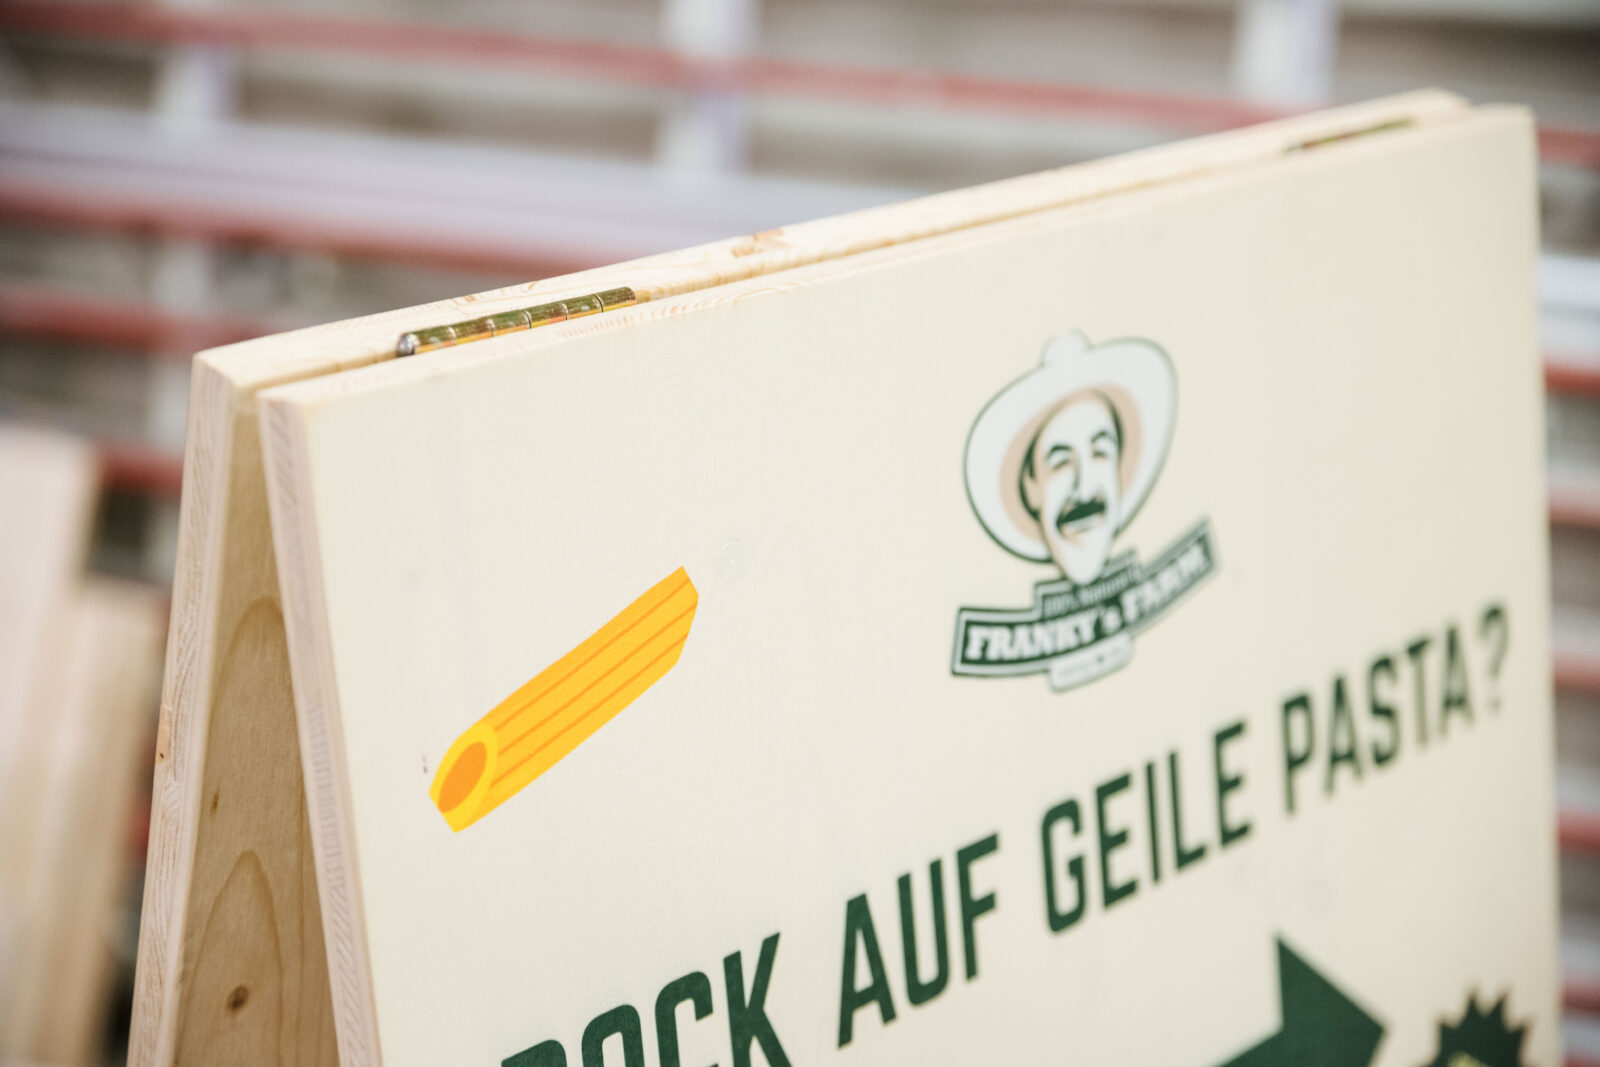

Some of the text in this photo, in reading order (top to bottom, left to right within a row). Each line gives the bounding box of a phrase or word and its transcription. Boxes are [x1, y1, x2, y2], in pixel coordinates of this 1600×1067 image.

[1121, 543, 1206, 622] FARM
[838, 832, 1000, 1049] AUF
[1041, 720, 1253, 935] GEILE
[1281, 603, 1509, 818] PASTA?
